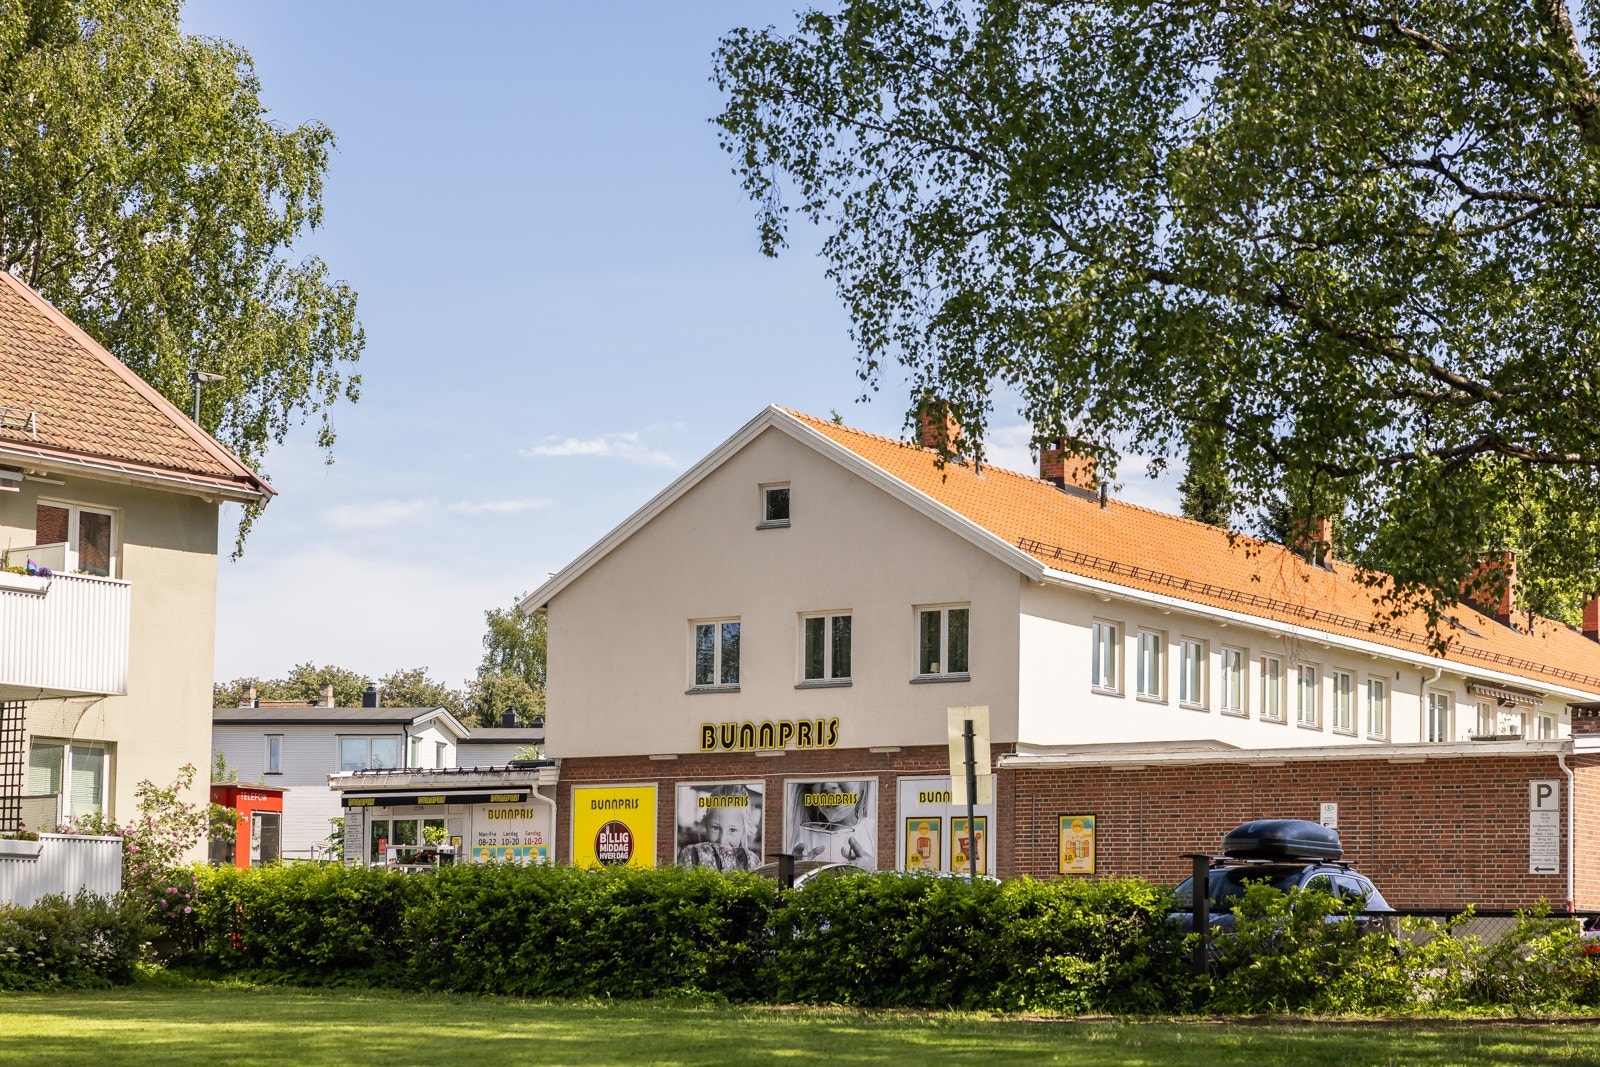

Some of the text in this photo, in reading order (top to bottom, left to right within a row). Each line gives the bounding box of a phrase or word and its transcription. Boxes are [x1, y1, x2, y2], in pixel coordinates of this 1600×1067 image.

[700, 717, 839, 751] BUNNPRIS
[241, 792, 267, 801] TELEFON
[804, 793, 859, 806] BUNNPRIS
[919, 791, 952, 804] BUNN
[1537, 784, 1552, 807] P
[591, 799, 639, 810] BUNNPRIS
[698, 796, 749, 808] BUNNPRIS
[488, 808, 534, 820] BUNNPRIS
[502, 838, 520, 846] 10-20
[600, 831, 629, 844] BILLIG
[599, 844, 629, 852] MIDDAG
[599, 852, 616, 860] HVER
